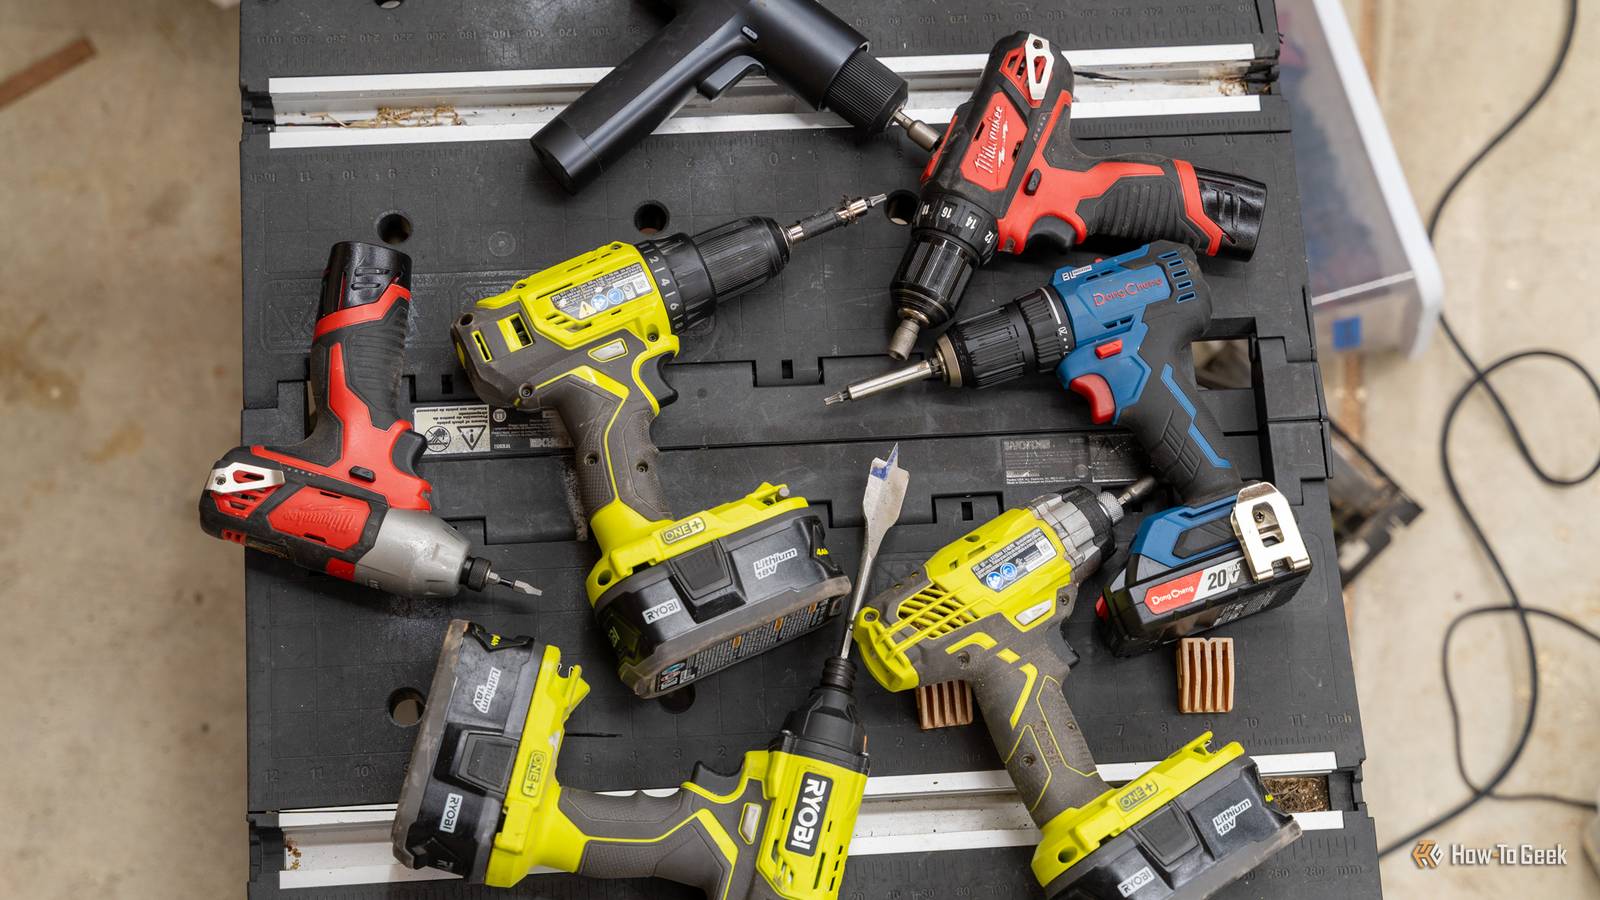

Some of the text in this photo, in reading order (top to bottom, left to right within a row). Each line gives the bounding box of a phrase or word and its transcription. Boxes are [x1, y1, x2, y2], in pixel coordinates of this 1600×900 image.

[974, 105, 1003, 174] Milwaukee
[941, 206, 953, 219] 16
[965, 216, 978, 230] 14
[984, 230, 995, 244] 12
[649, 255, 660, 265] 2
[661, 278, 671, 287] 4
[1062, 270, 1077, 282] BL
[670, 302, 680, 311] 6
[755, 550, 796, 571] Lithium
[757, 566, 777, 578] 18V
[645, 600, 678, 621] RYOBI
[474, 687, 484, 708] 18V
[481, 669, 499, 712] Lithium
[1159, 721, 1168, 734] 8
[1243, 717, 1259, 730] 10
[354, 765, 370, 778] 10
[443, 797, 460, 830] RYOBI
[790, 778, 828, 850] RYOBI
[1214, 800, 1250, 826] Lithium
[1218, 819, 1236, 835] 18V
[1121, 870, 1152, 893] RYOBI
